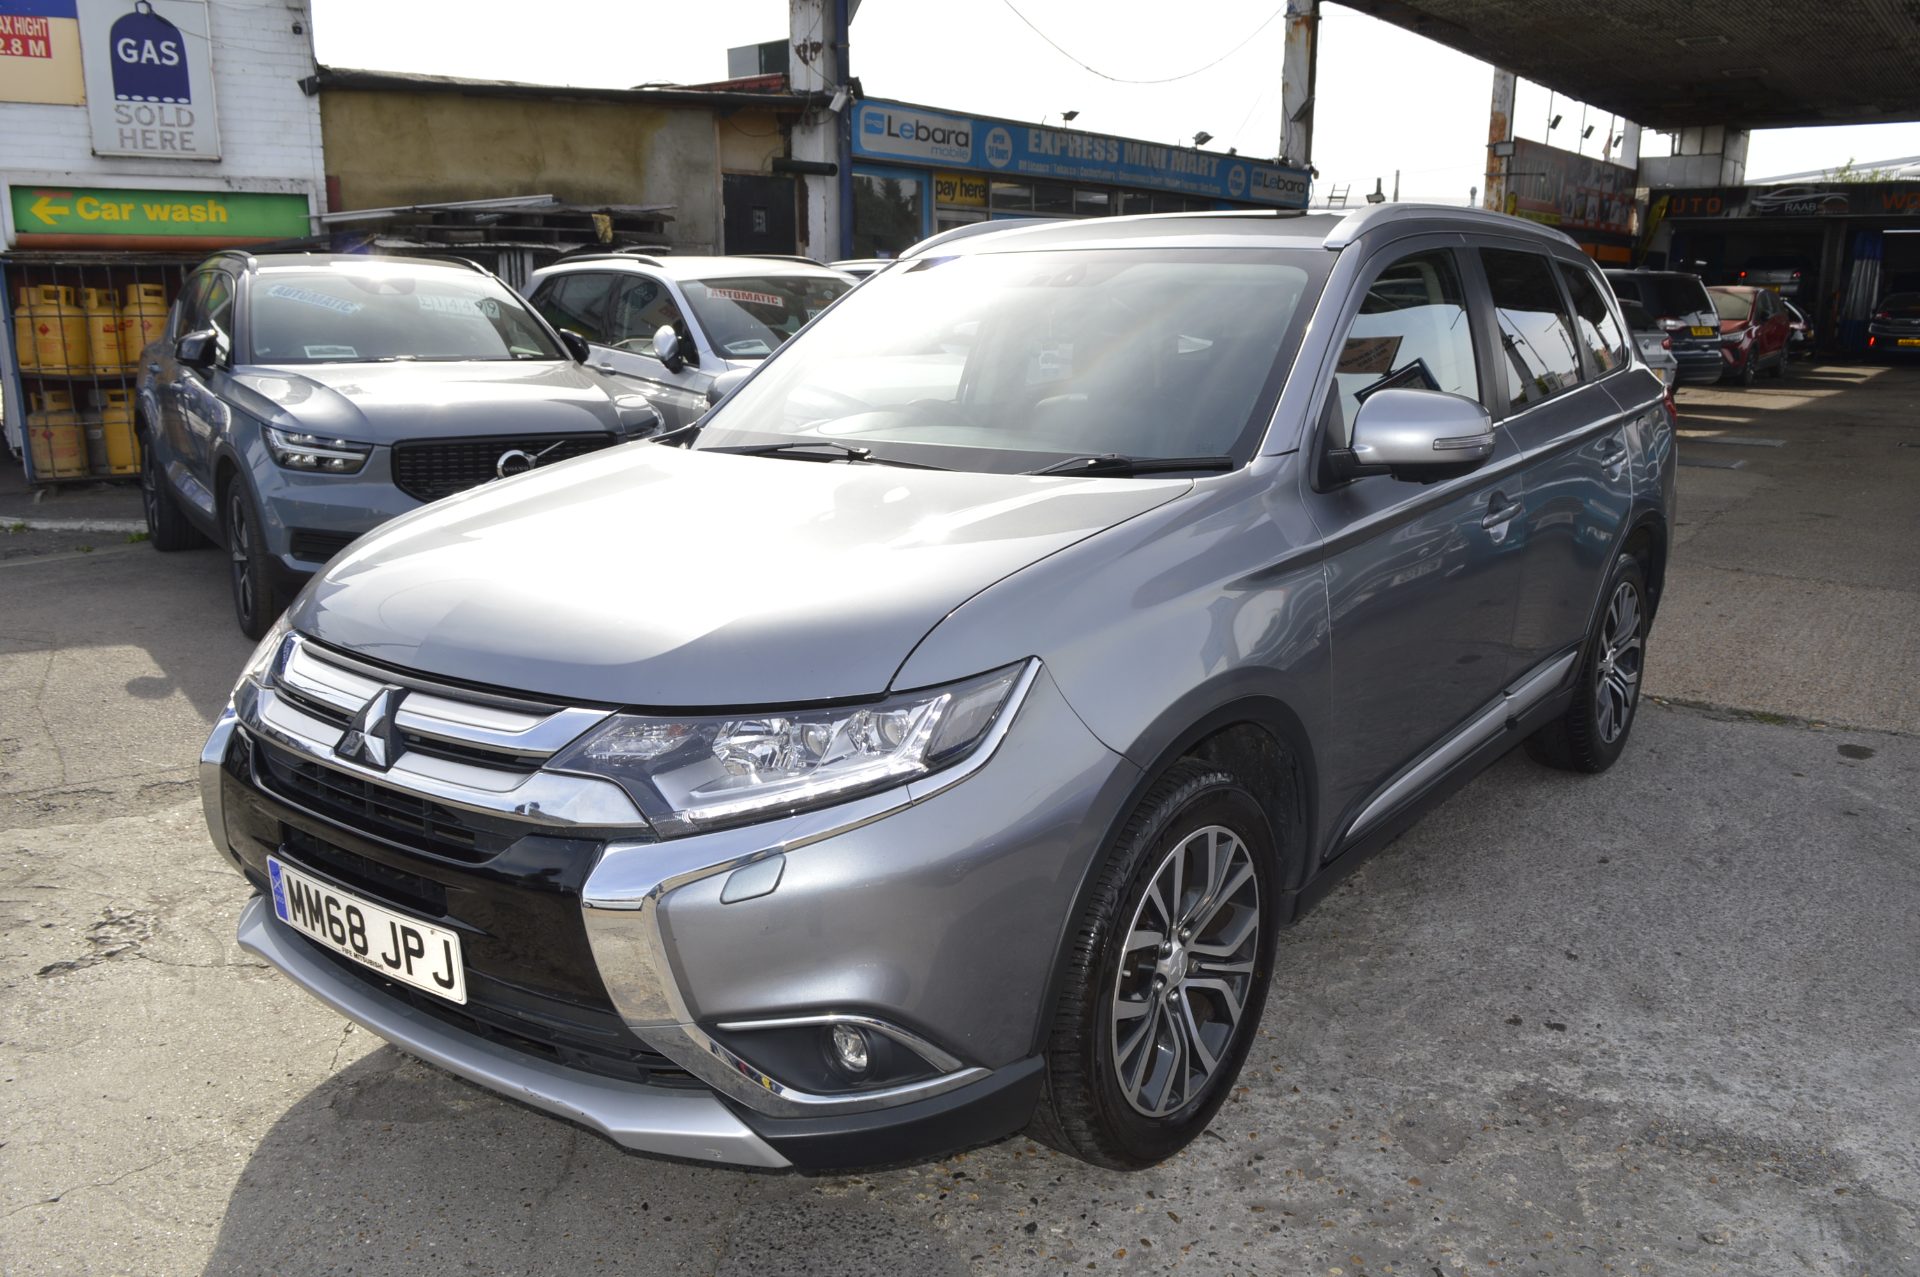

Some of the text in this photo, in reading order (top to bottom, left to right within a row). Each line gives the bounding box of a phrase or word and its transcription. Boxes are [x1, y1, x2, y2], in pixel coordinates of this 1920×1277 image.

[13, 16, 48, 37] HIGHT
[28, 39, 47, 57] M
[117, 37, 179, 66] GAS
[116, 104, 196, 127] SOLD
[118, 128, 197, 151] HERE
[886, 114, 970, 148] Lebara
[930, 145, 969, 160] mobile
[1028, 128, 1119, 163] EXPRESS
[1124, 142, 1167, 170] MINI
[1171, 150, 1221, 178] MART
[935, 175, 986, 201] pay here
[1263, 172, 1306, 193] Lebara
[76, 195, 229, 223] Car wash
[1671, 195, 1722, 214] UTO
[273, 285, 355, 312] AUTOMATIC
[710, 288, 779, 306] AUTOMATIC
[285, 873, 456, 990] MM68 JPJ
